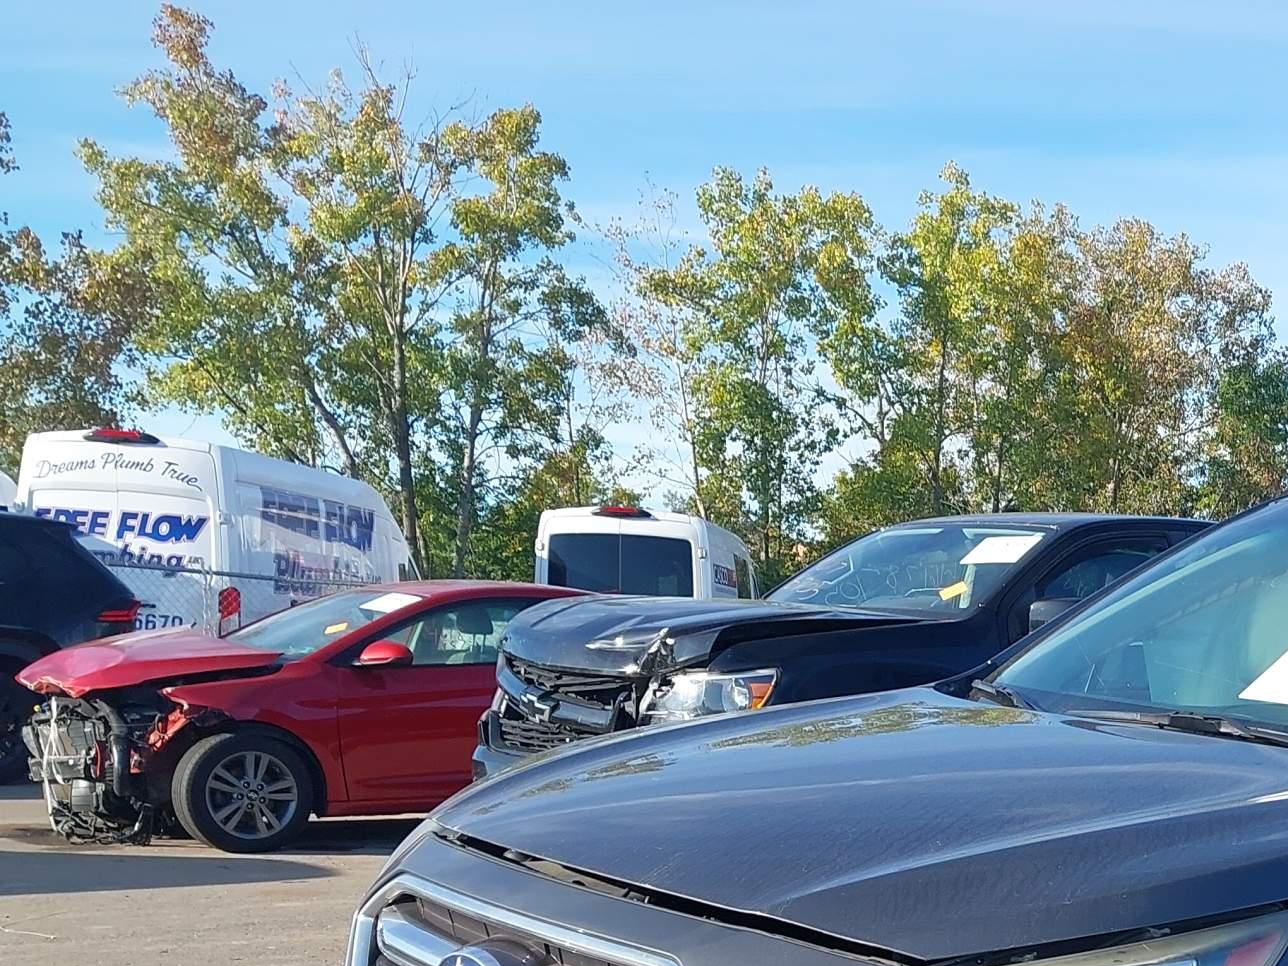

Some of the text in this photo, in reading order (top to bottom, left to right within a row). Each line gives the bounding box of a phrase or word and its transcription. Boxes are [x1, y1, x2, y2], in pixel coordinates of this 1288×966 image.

[33, 452, 203, 491] Dreams Plumb True
[116, 511, 209, 542] FLOW
